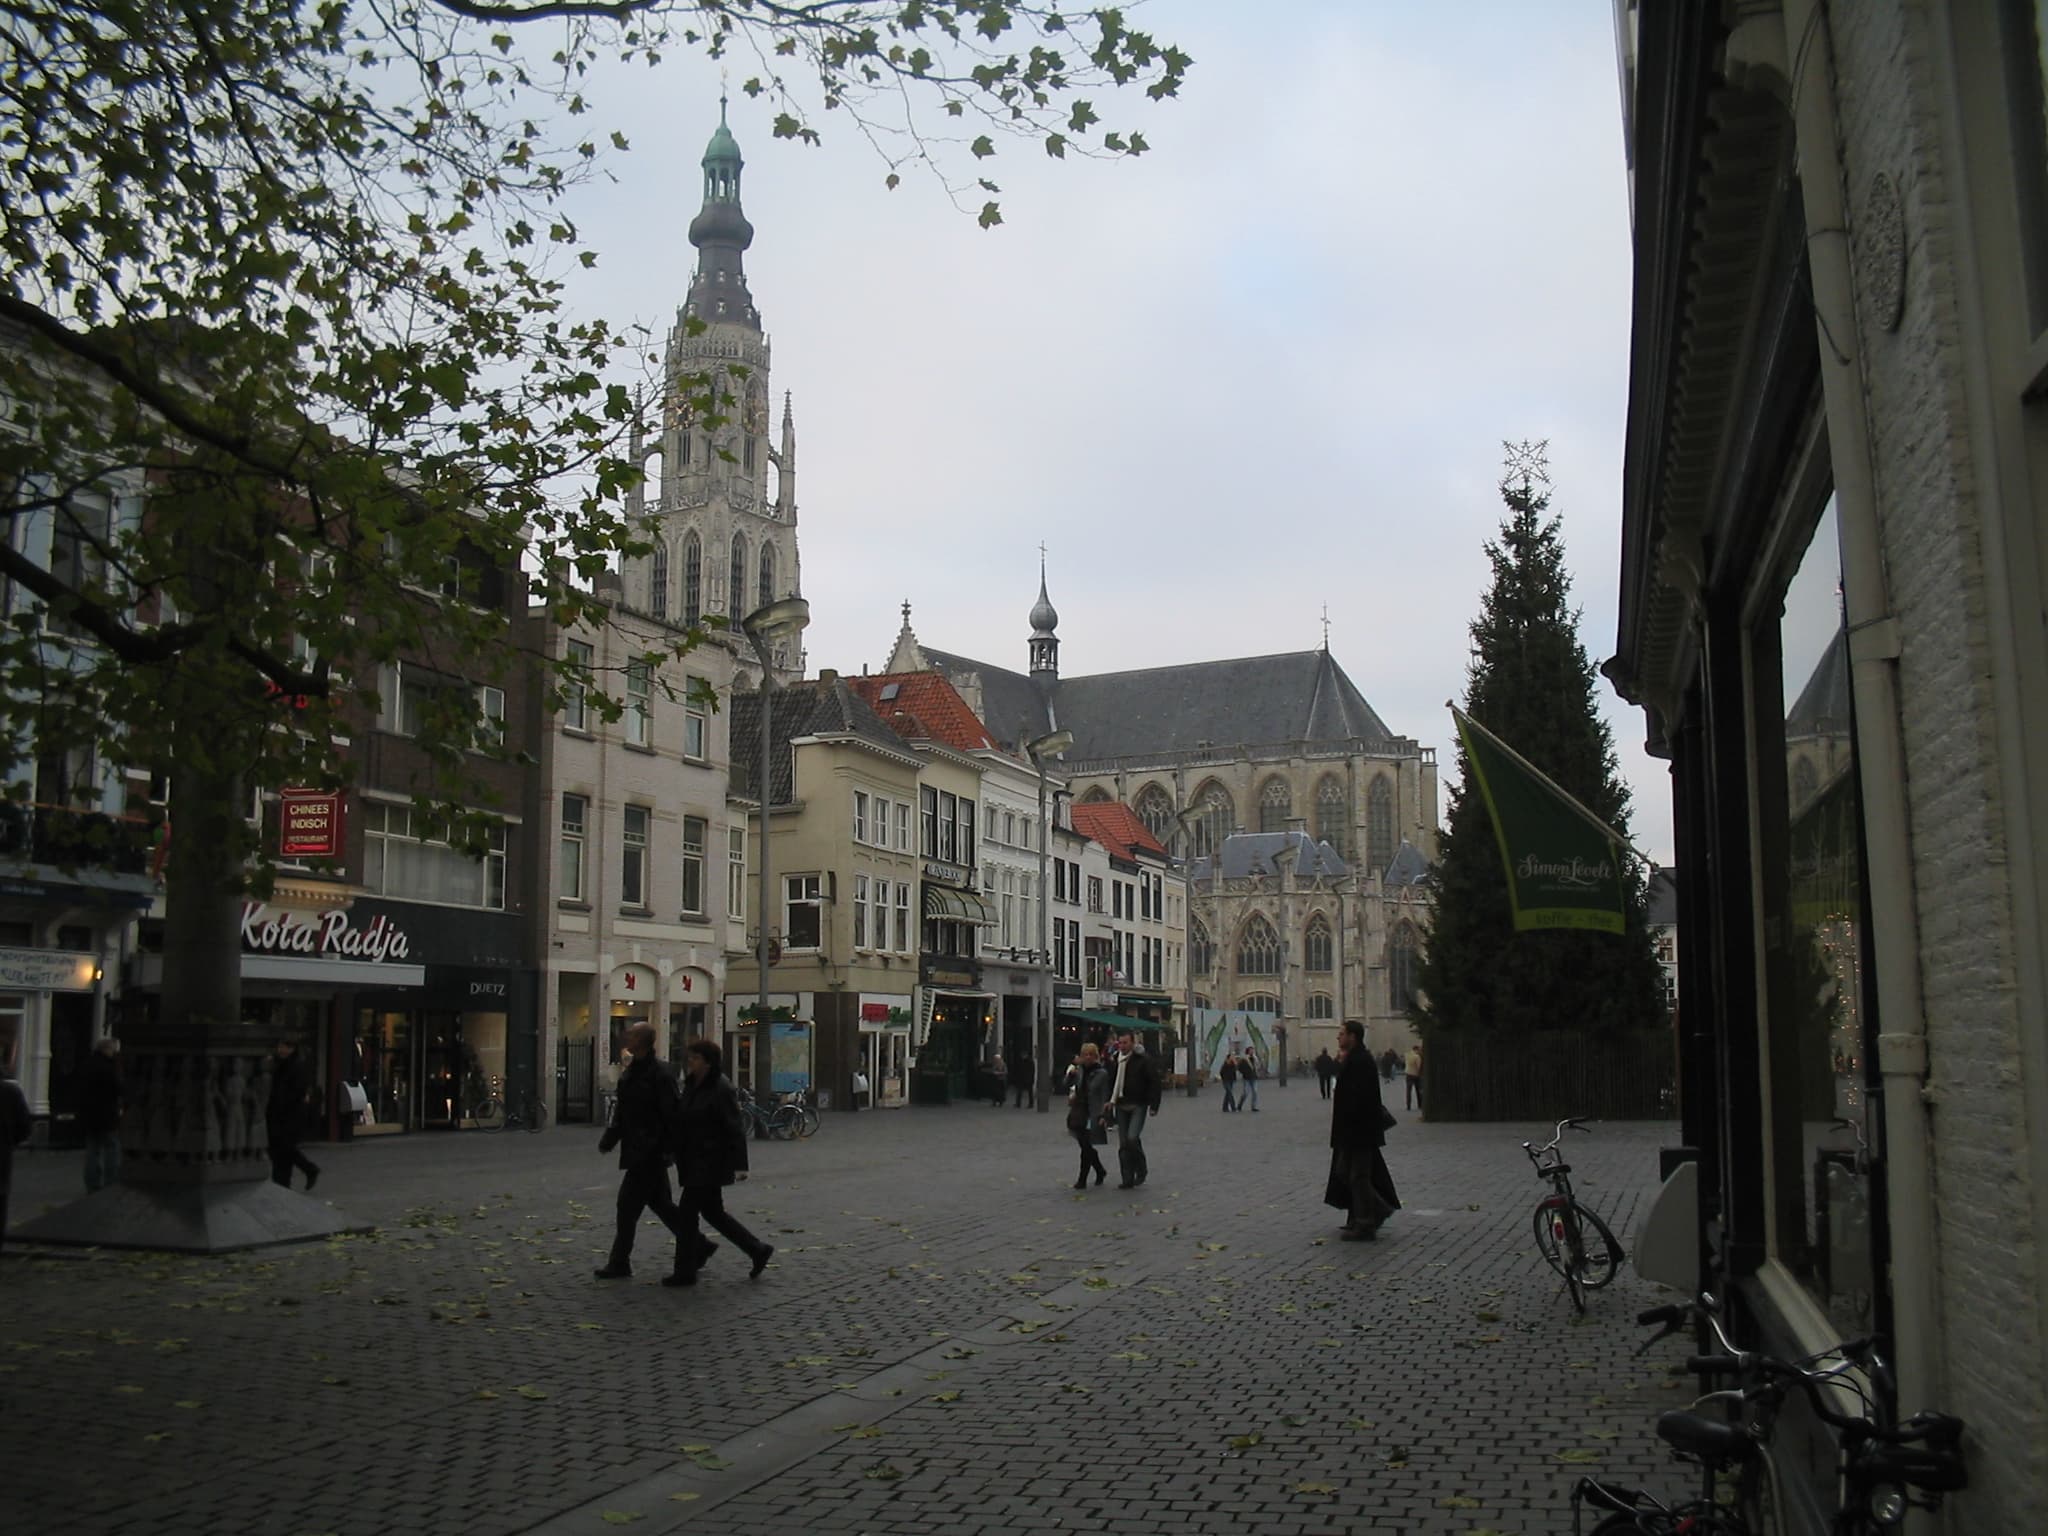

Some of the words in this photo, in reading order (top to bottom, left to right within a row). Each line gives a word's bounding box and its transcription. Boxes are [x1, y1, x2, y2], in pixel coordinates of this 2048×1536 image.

[290, 804, 329, 815] CHINEES
[290, 818, 328, 829] INDISCH
[1517, 853, 1570, 879] Simon
[241, 901, 315, 951] Kota
[321, 909, 408, 963] Radja
